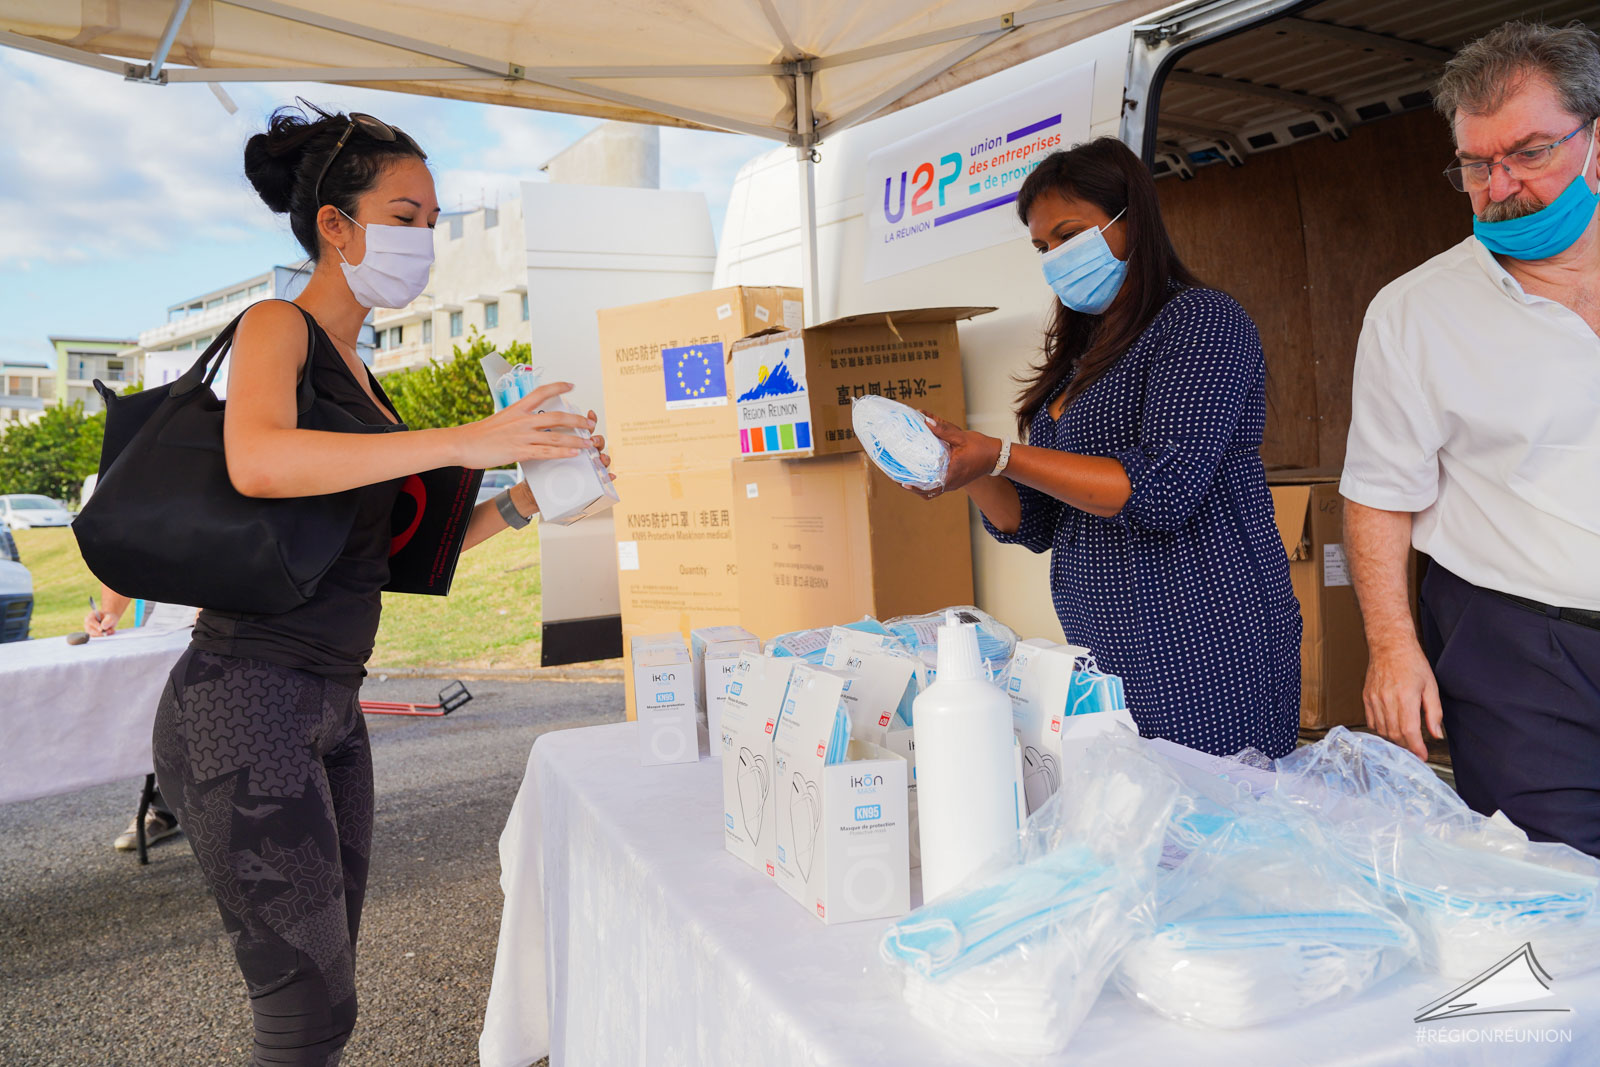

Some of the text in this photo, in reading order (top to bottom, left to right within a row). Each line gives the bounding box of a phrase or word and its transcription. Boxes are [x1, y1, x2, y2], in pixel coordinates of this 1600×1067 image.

[970, 136, 1002, 157] union
[968, 133, 1062, 176] des entreprises
[884, 152, 963, 224] U2P
[984, 175, 998, 190] de
[884, 232, 895, 244] LA
[743, 407, 767, 421] REGION
[726, 564, 738, 576] PC
[856, 806, 879, 820] KN95
[869, 821, 896, 829] protection
